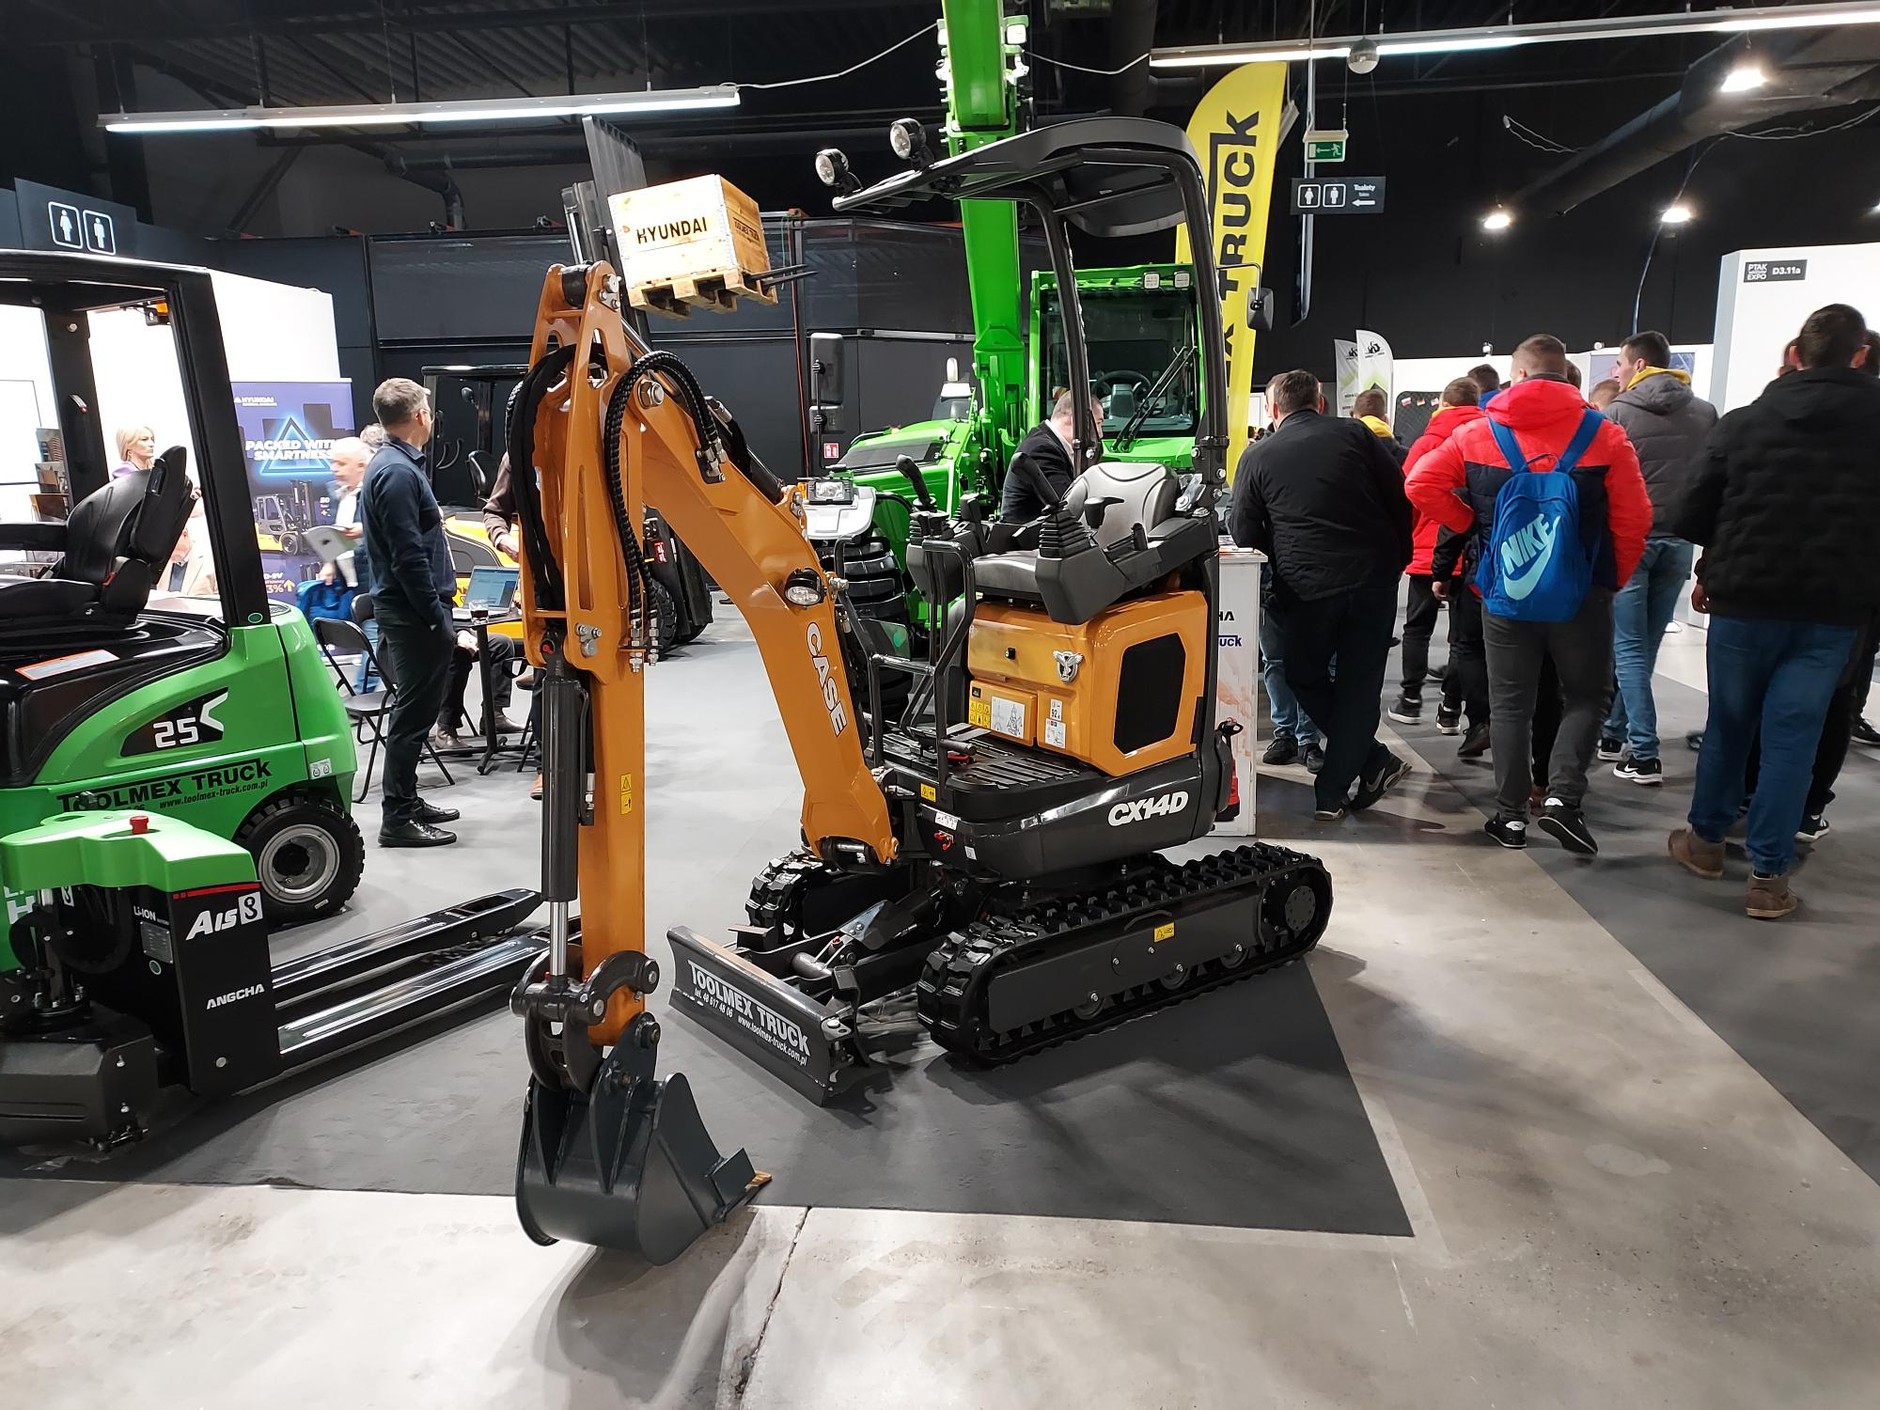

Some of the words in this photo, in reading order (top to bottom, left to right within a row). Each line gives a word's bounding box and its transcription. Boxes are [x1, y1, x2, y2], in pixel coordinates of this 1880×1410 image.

[1209, 110, 1260, 300] TRUCK
[636, 216, 708, 244] HYUNDAI
[1748, 263, 1767, 271] PTAK
[1772, 266, 1801, 275] D3.11a
[245, 440, 302, 451] PACKED
[1501, 513, 1554, 576] NIKE
[1219, 635, 1242, 647] UCK
[806, 621, 847, 738] CASE
[152, 717, 199, 749] 25
[191, 757, 273, 791] TRUCK
[159, 779, 269, 809] www.toolmex-truck.com.pl
[1108, 791, 1189, 827] CX14D
[206, 983, 265, 1010] ANGCHA
[687, 959, 754, 1020] TOOLMEX
[756, 1004, 811, 1057] TRUCK
[738, 1015, 807, 1066] www.toolmex-truck.com.pl
